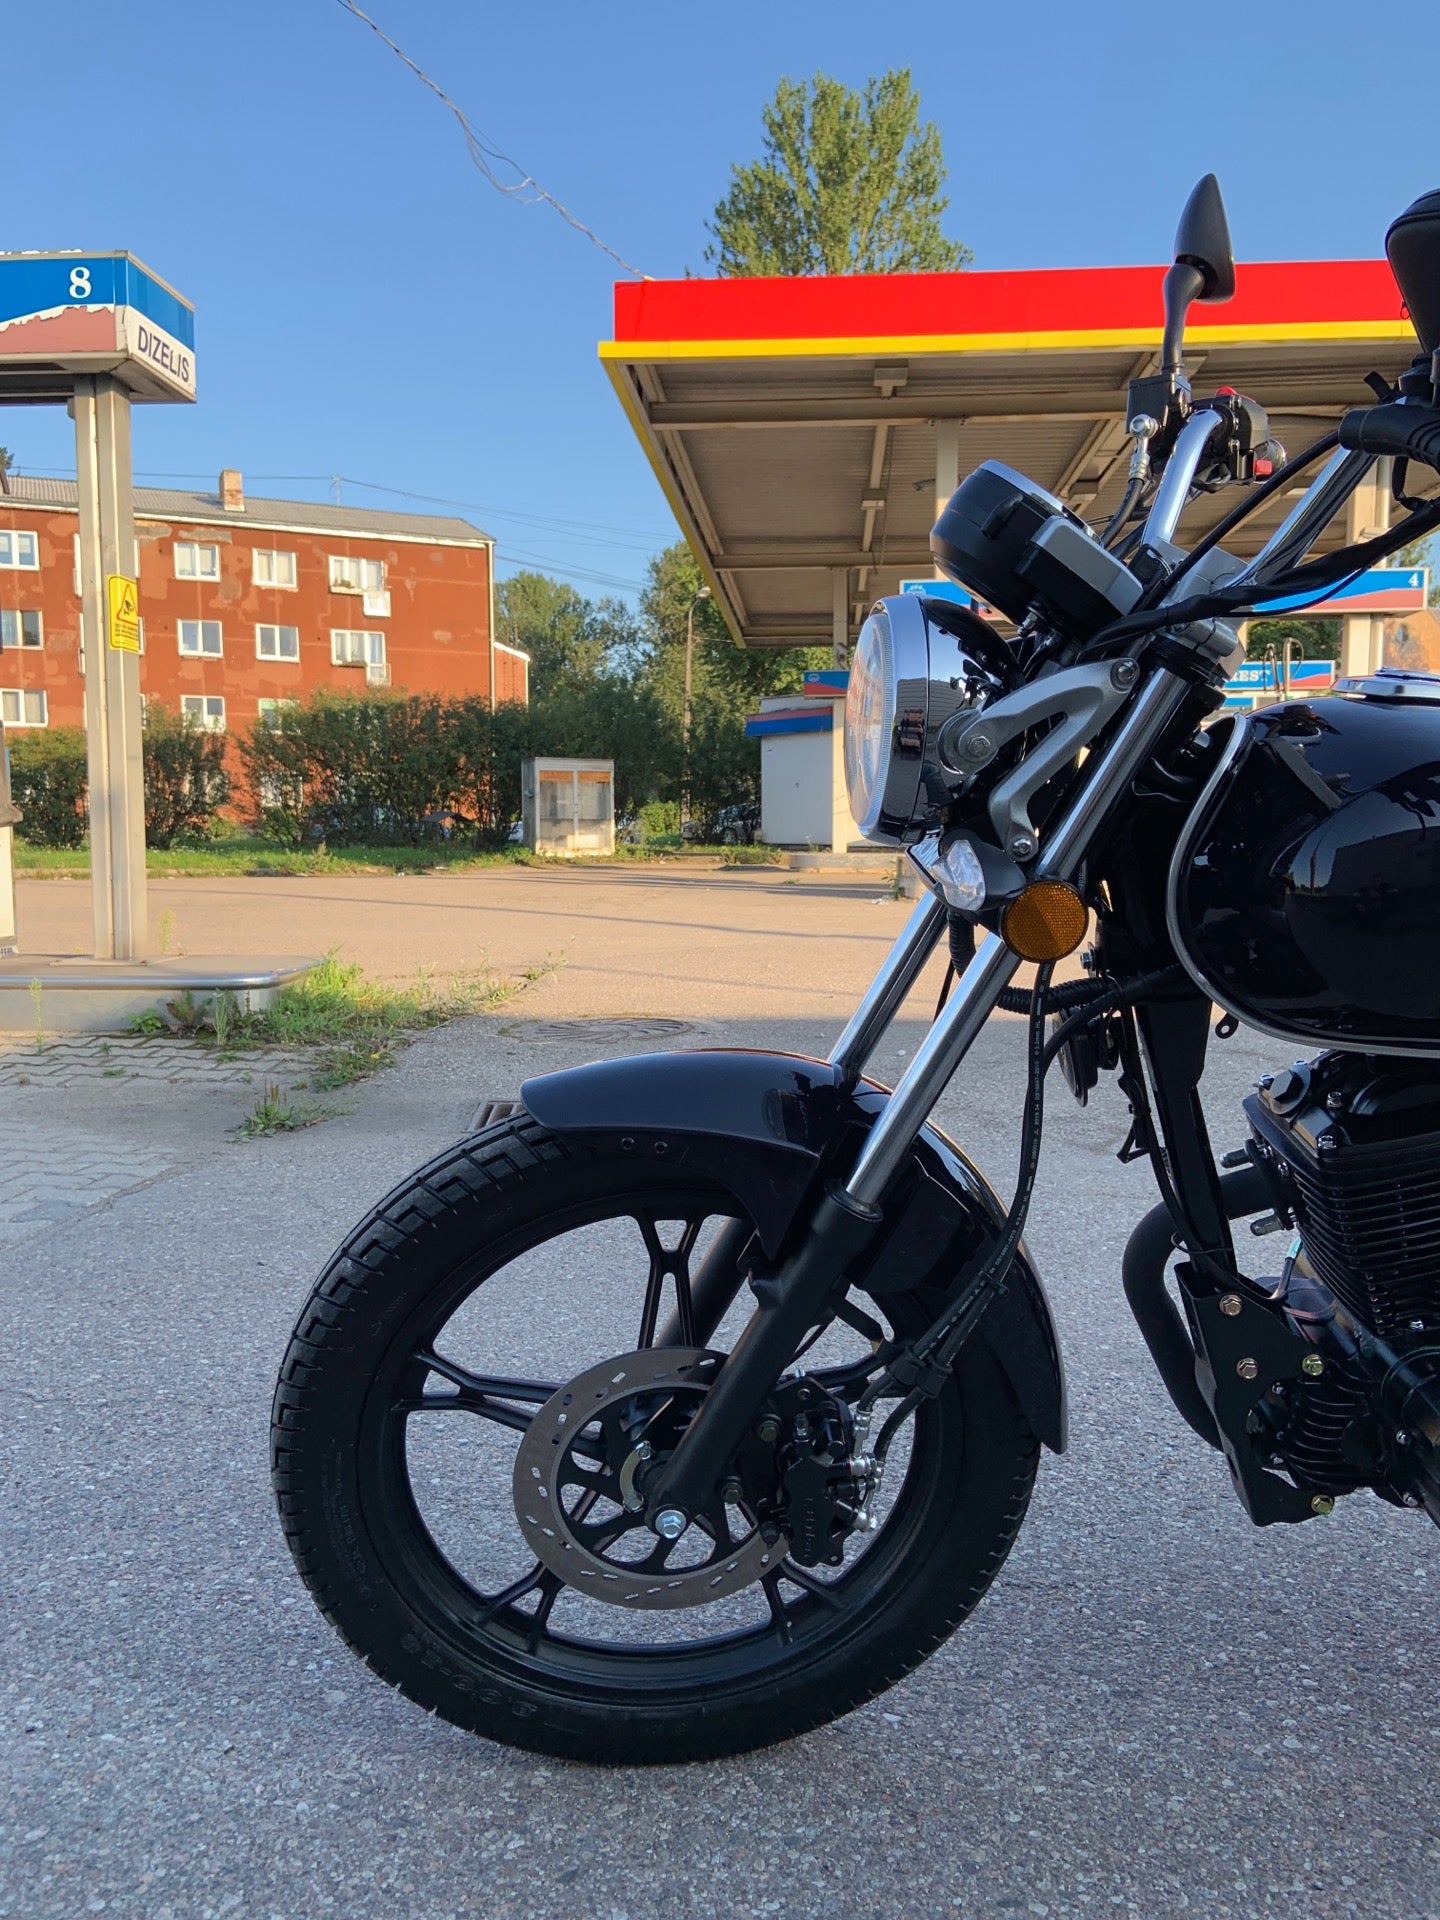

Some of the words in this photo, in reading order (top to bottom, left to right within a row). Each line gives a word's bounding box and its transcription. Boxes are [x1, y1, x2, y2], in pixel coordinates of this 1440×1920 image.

[69, 266, 92, 299] 8
[138, 325, 189, 383] DIZELIS
[1408, 573, 1419, 587] 4
